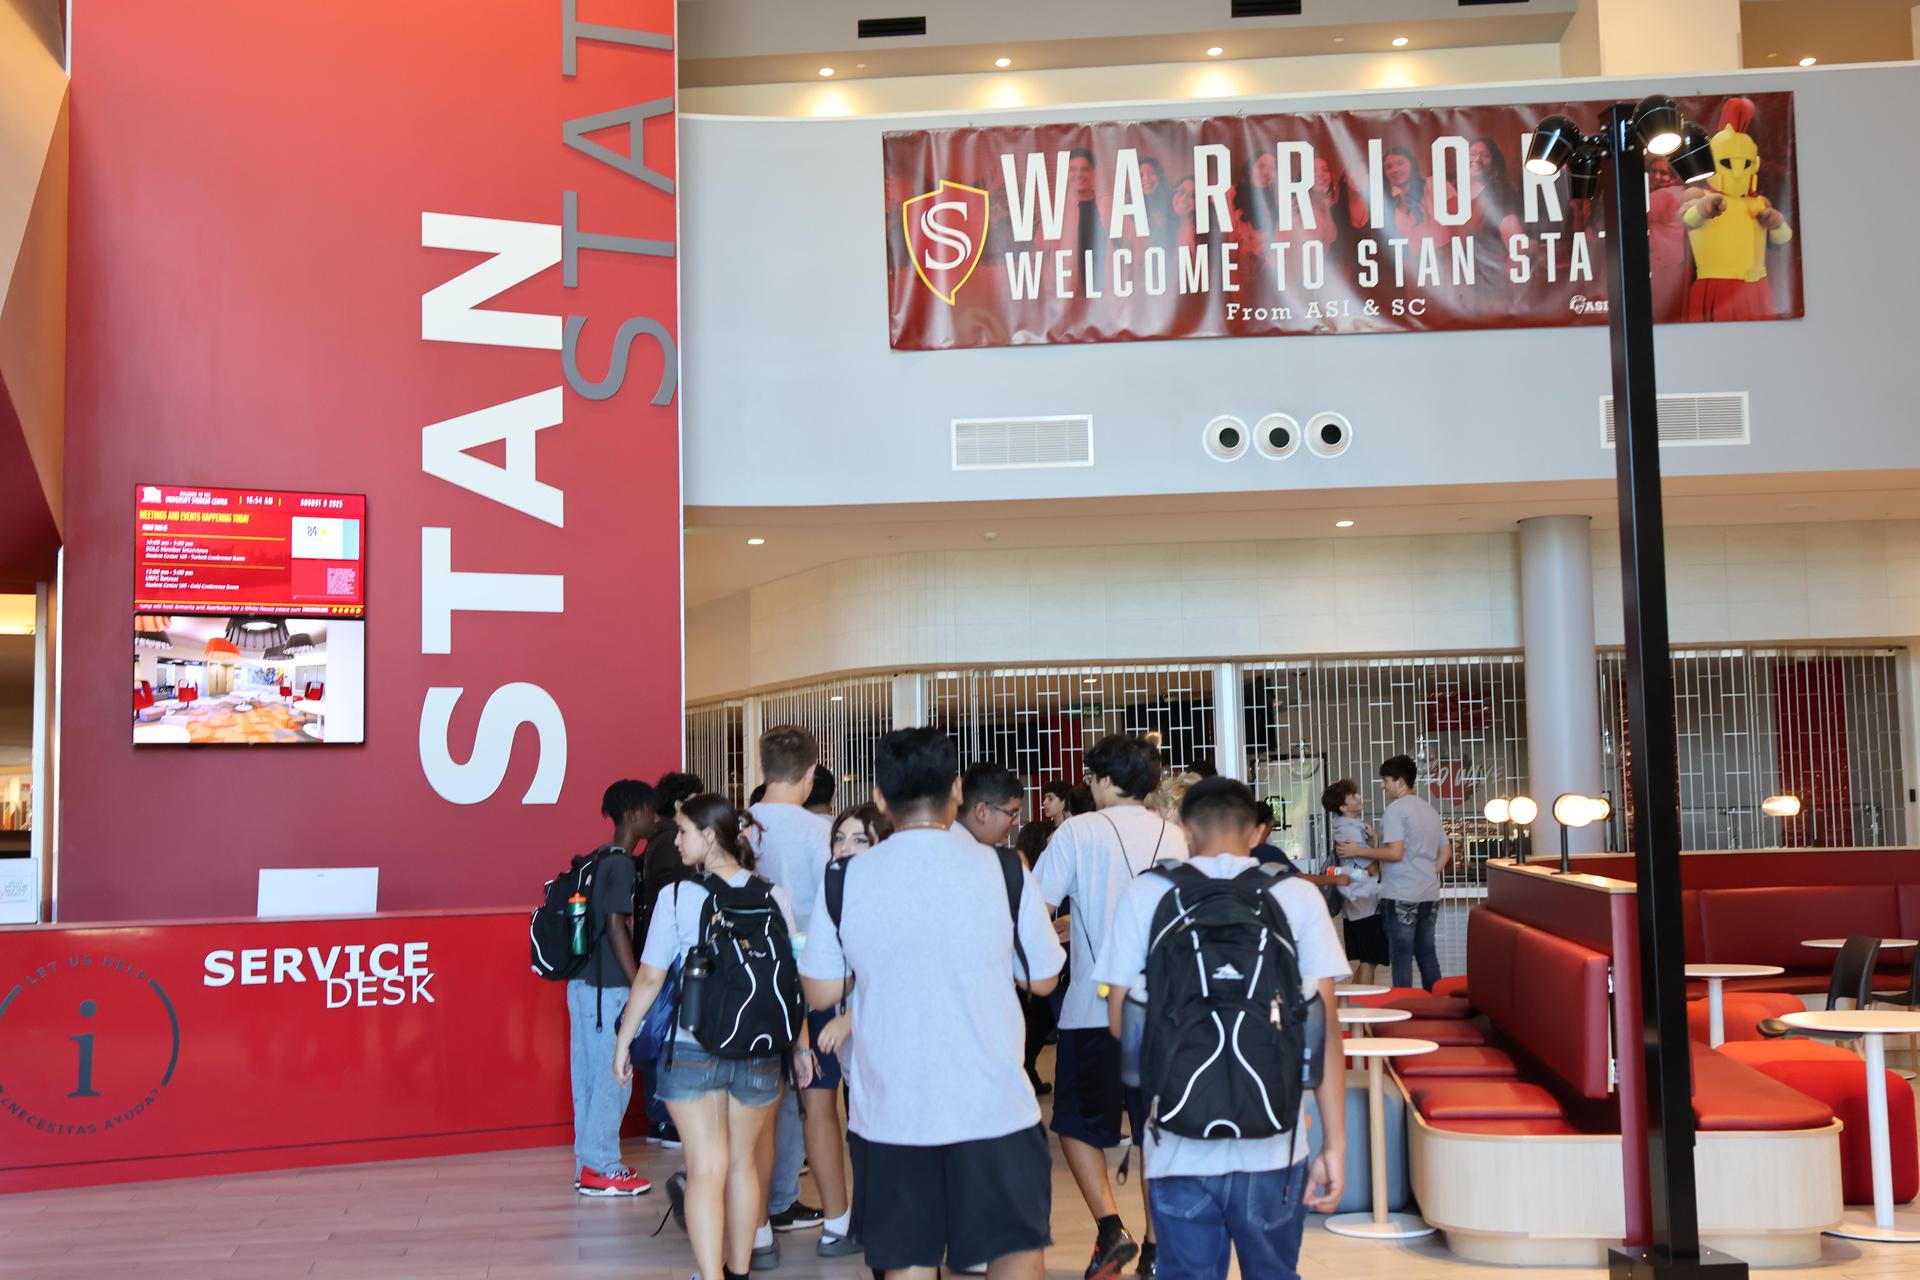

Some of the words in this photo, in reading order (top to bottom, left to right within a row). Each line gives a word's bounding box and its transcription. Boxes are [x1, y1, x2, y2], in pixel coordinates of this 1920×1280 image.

[1001, 133, 1651, 242] WARRIOR
[1005, 242, 1240, 300] WELCOME
[1271, 239, 1324, 292] TO
[1358, 235, 1476, 288] STAN
[1508, 231, 1651, 284] STA
[1226, 303, 1292, 321] From
[1305, 300, 1350, 319] ASI
[1363, 298, 1380, 316] &
[1391, 298, 1426, 316] SC
[140, 510, 167, 520] MEETINGS
[168, 511, 179, 521] AND
[180, 511, 200, 522] EVENTS
[202, 512, 232, 523] HAPPENING
[233, 513, 249, 524] TODAY
[300, 498, 322, 507] AUGUST
[419, 211, 567, 805] STAN
[25, 960, 57, 985] LET
[68, 955, 92, 967] US
[102, 956, 148, 979] HELP
[203, 941, 429, 987] SERVICE
[326, 972, 435, 1009] DESK
[105, 1088, 160, 1130] AYUDA?
